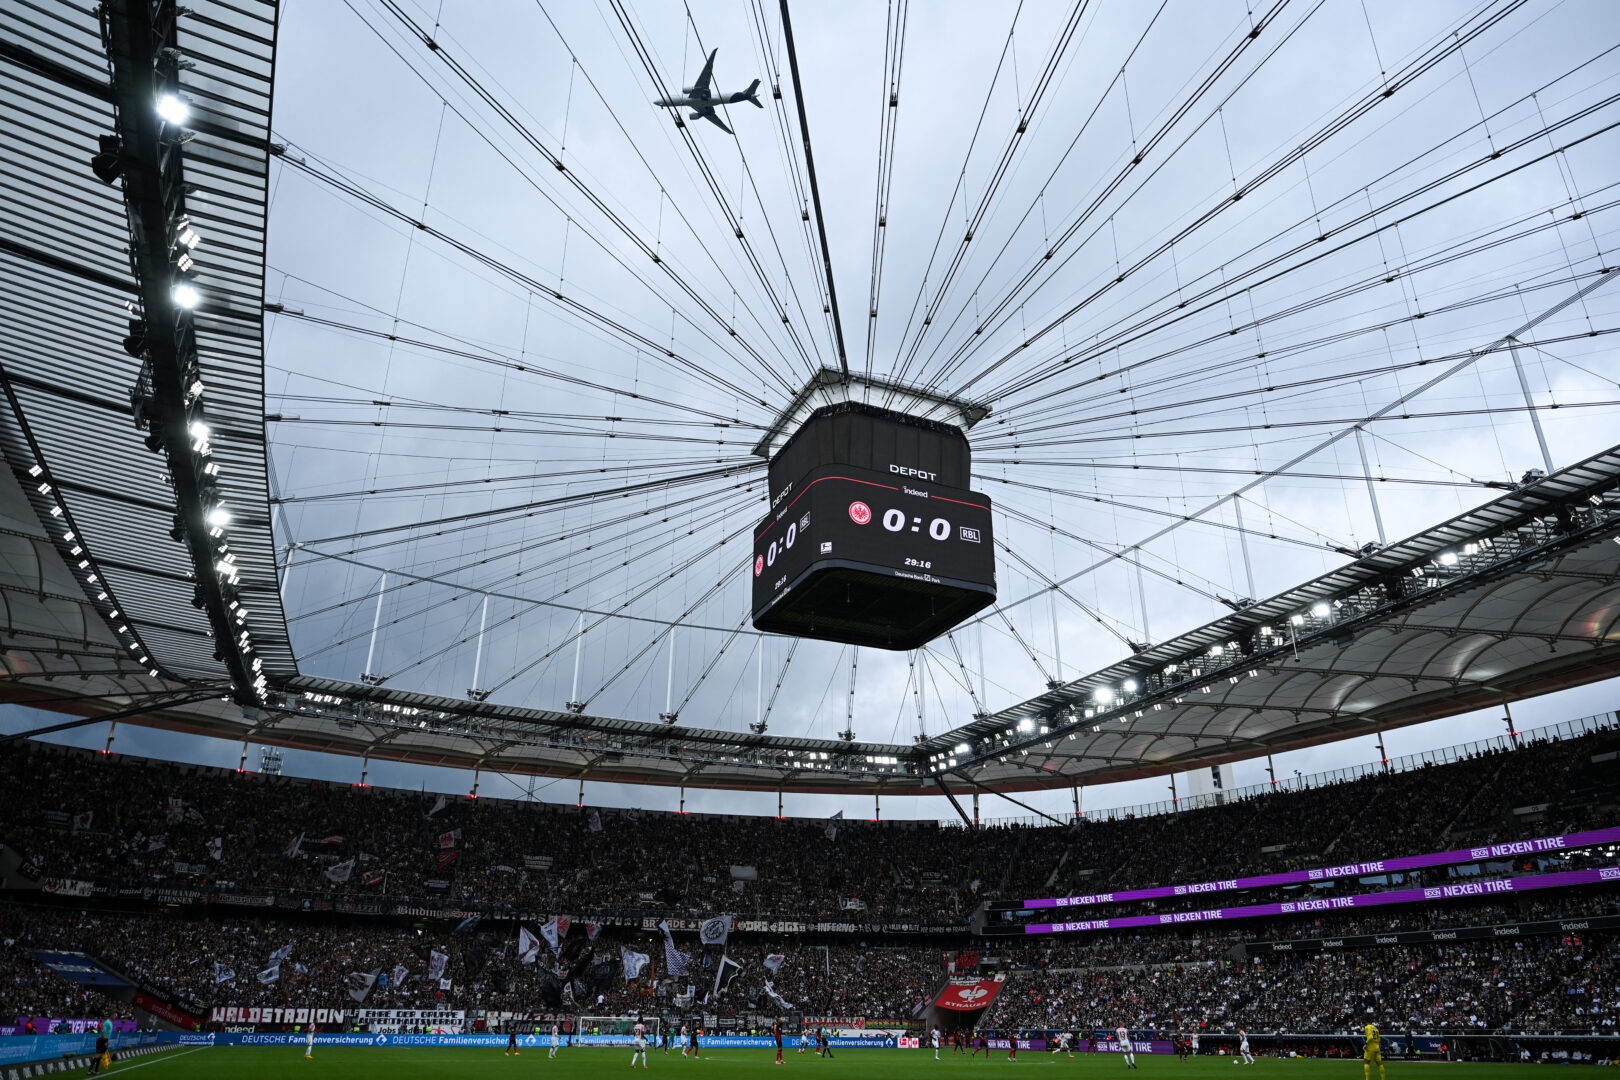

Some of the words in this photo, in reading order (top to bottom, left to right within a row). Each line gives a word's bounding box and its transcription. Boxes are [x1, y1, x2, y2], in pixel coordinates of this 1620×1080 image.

[889, 463, 937, 481] DEPOT
[772, 481, 793, 508] DEPOT
[903, 486, 928, 498] indeed
[962, 528, 979, 541] RBL
[904, 557, 931, 569] 29:16
[1491, 841, 1533, 857] NEXEN
[1535, 836, 1566, 850] TIRE
[1325, 865, 1359, 878] NEXEN
[1360, 862, 1385, 873] TIRE
[1188, 882, 1217, 893] NEXEN
[1217, 880, 1238, 890] TIRE
[1443, 883, 1483, 897] NEXEN
[1485, 880, 1514, 892] TIRE
[1069, 896, 1095, 905] NEXEN
[1096, 893, 1113, 902] TIRE
[1297, 899, 1329, 911] NEXEN
[1331, 897, 1355, 908] TIRE
[1173, 911, 1201, 922] NEXEN
[1202, 910, 1222, 920] TIRE
[643, 919, 686, 929] BRADE
[1065, 921, 1091, 931] NEXEN
[1092, 920, 1109, 929] TIRE
[1561, 921, 1589, 930] indeed
[1432, 931, 1457, 940] indeed
[1493, 927, 1520, 935] indeed
[1272, 942, 1292, 950] indeed
[212, 1006, 344, 1024] WALDSTADION
[224, 1025, 255, 1033] ndeed
[242, 1035, 287, 1044] DEUTSCHE
[392, 1036, 437, 1044] DEUTSCHE
[827, 1039, 884, 1048] amilienversicherung
[1134, 1042, 1152, 1052] TIRE
